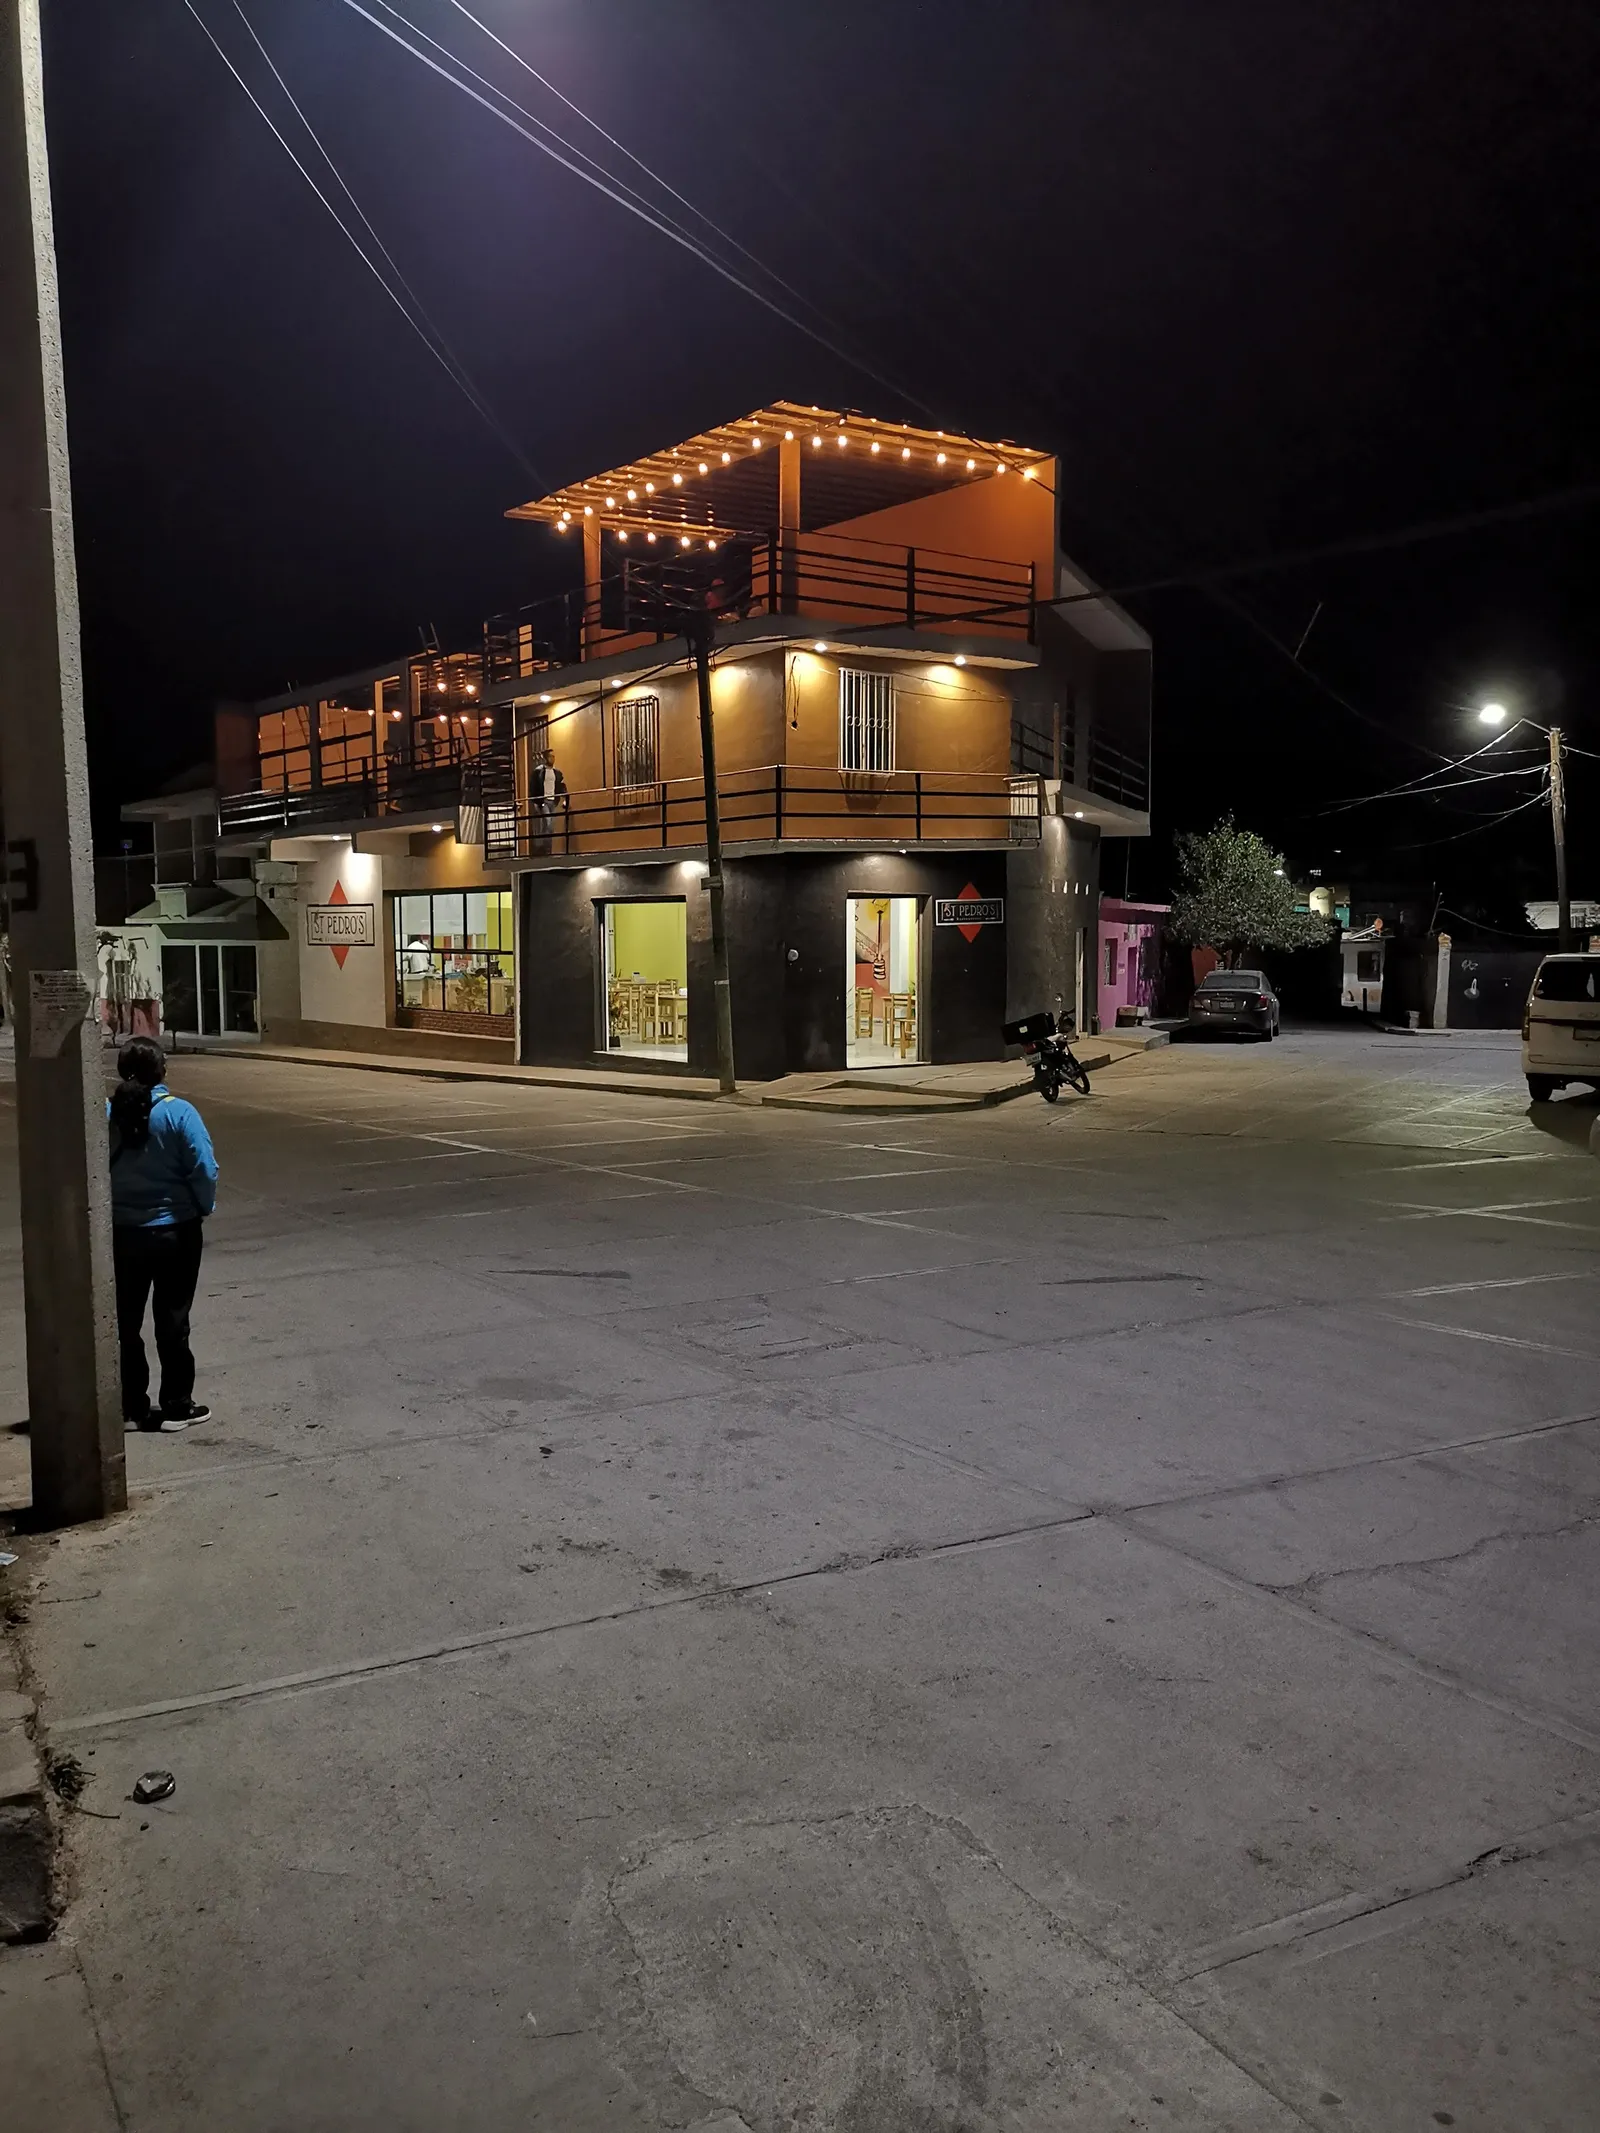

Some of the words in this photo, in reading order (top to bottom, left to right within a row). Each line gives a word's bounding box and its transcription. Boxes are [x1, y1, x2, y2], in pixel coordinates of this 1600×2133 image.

[944, 903, 956, 917] ST
[314, 912, 324, 934] ST
[327, 915, 365, 935] PEDRO'S
